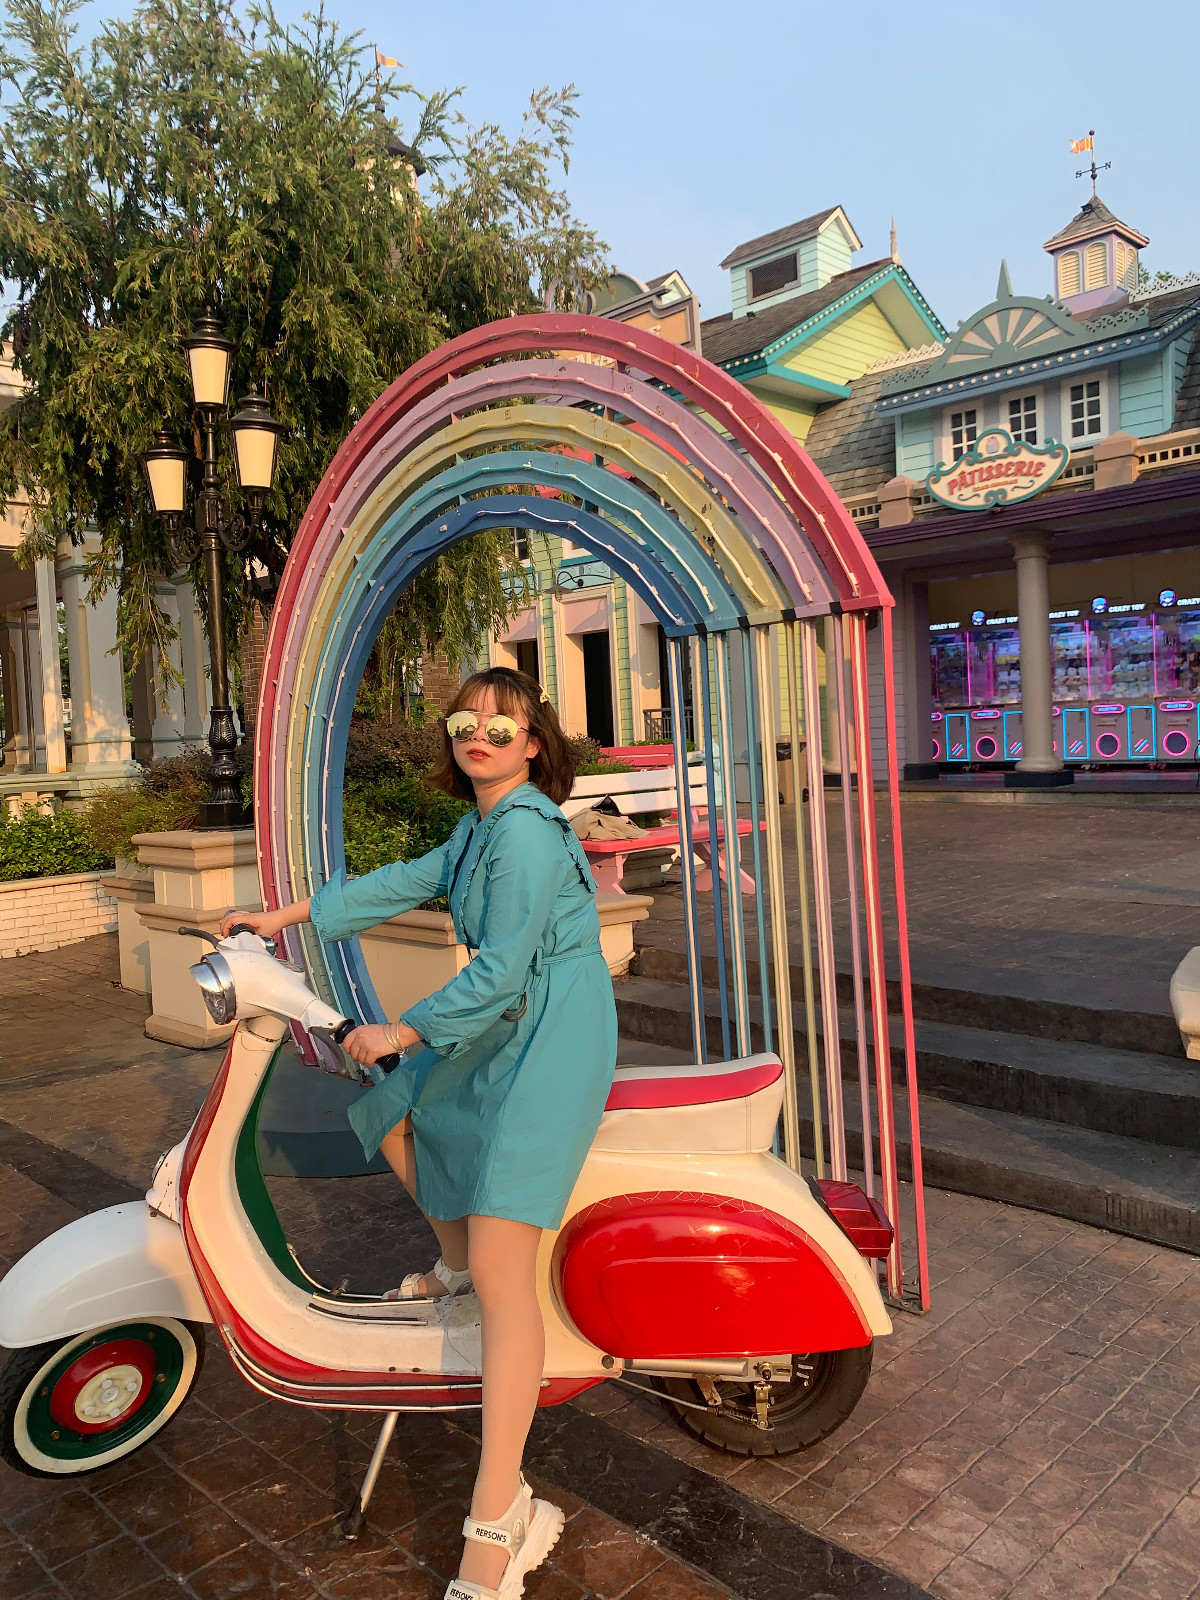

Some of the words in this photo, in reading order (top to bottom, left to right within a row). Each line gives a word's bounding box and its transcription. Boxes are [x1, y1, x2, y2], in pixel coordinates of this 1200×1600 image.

[947, 460, 1046, 495] PÂTISSERIE
[1108, 604, 1131, 613] CRAZY
[1131, 603, 1146, 611] TOY
[1048, 611, 1066, 619] RAZY
[929, 622, 948, 631] CRAZY
[948, 621, 960, 629] TOY
[986, 617, 1006, 625] CRAZY
